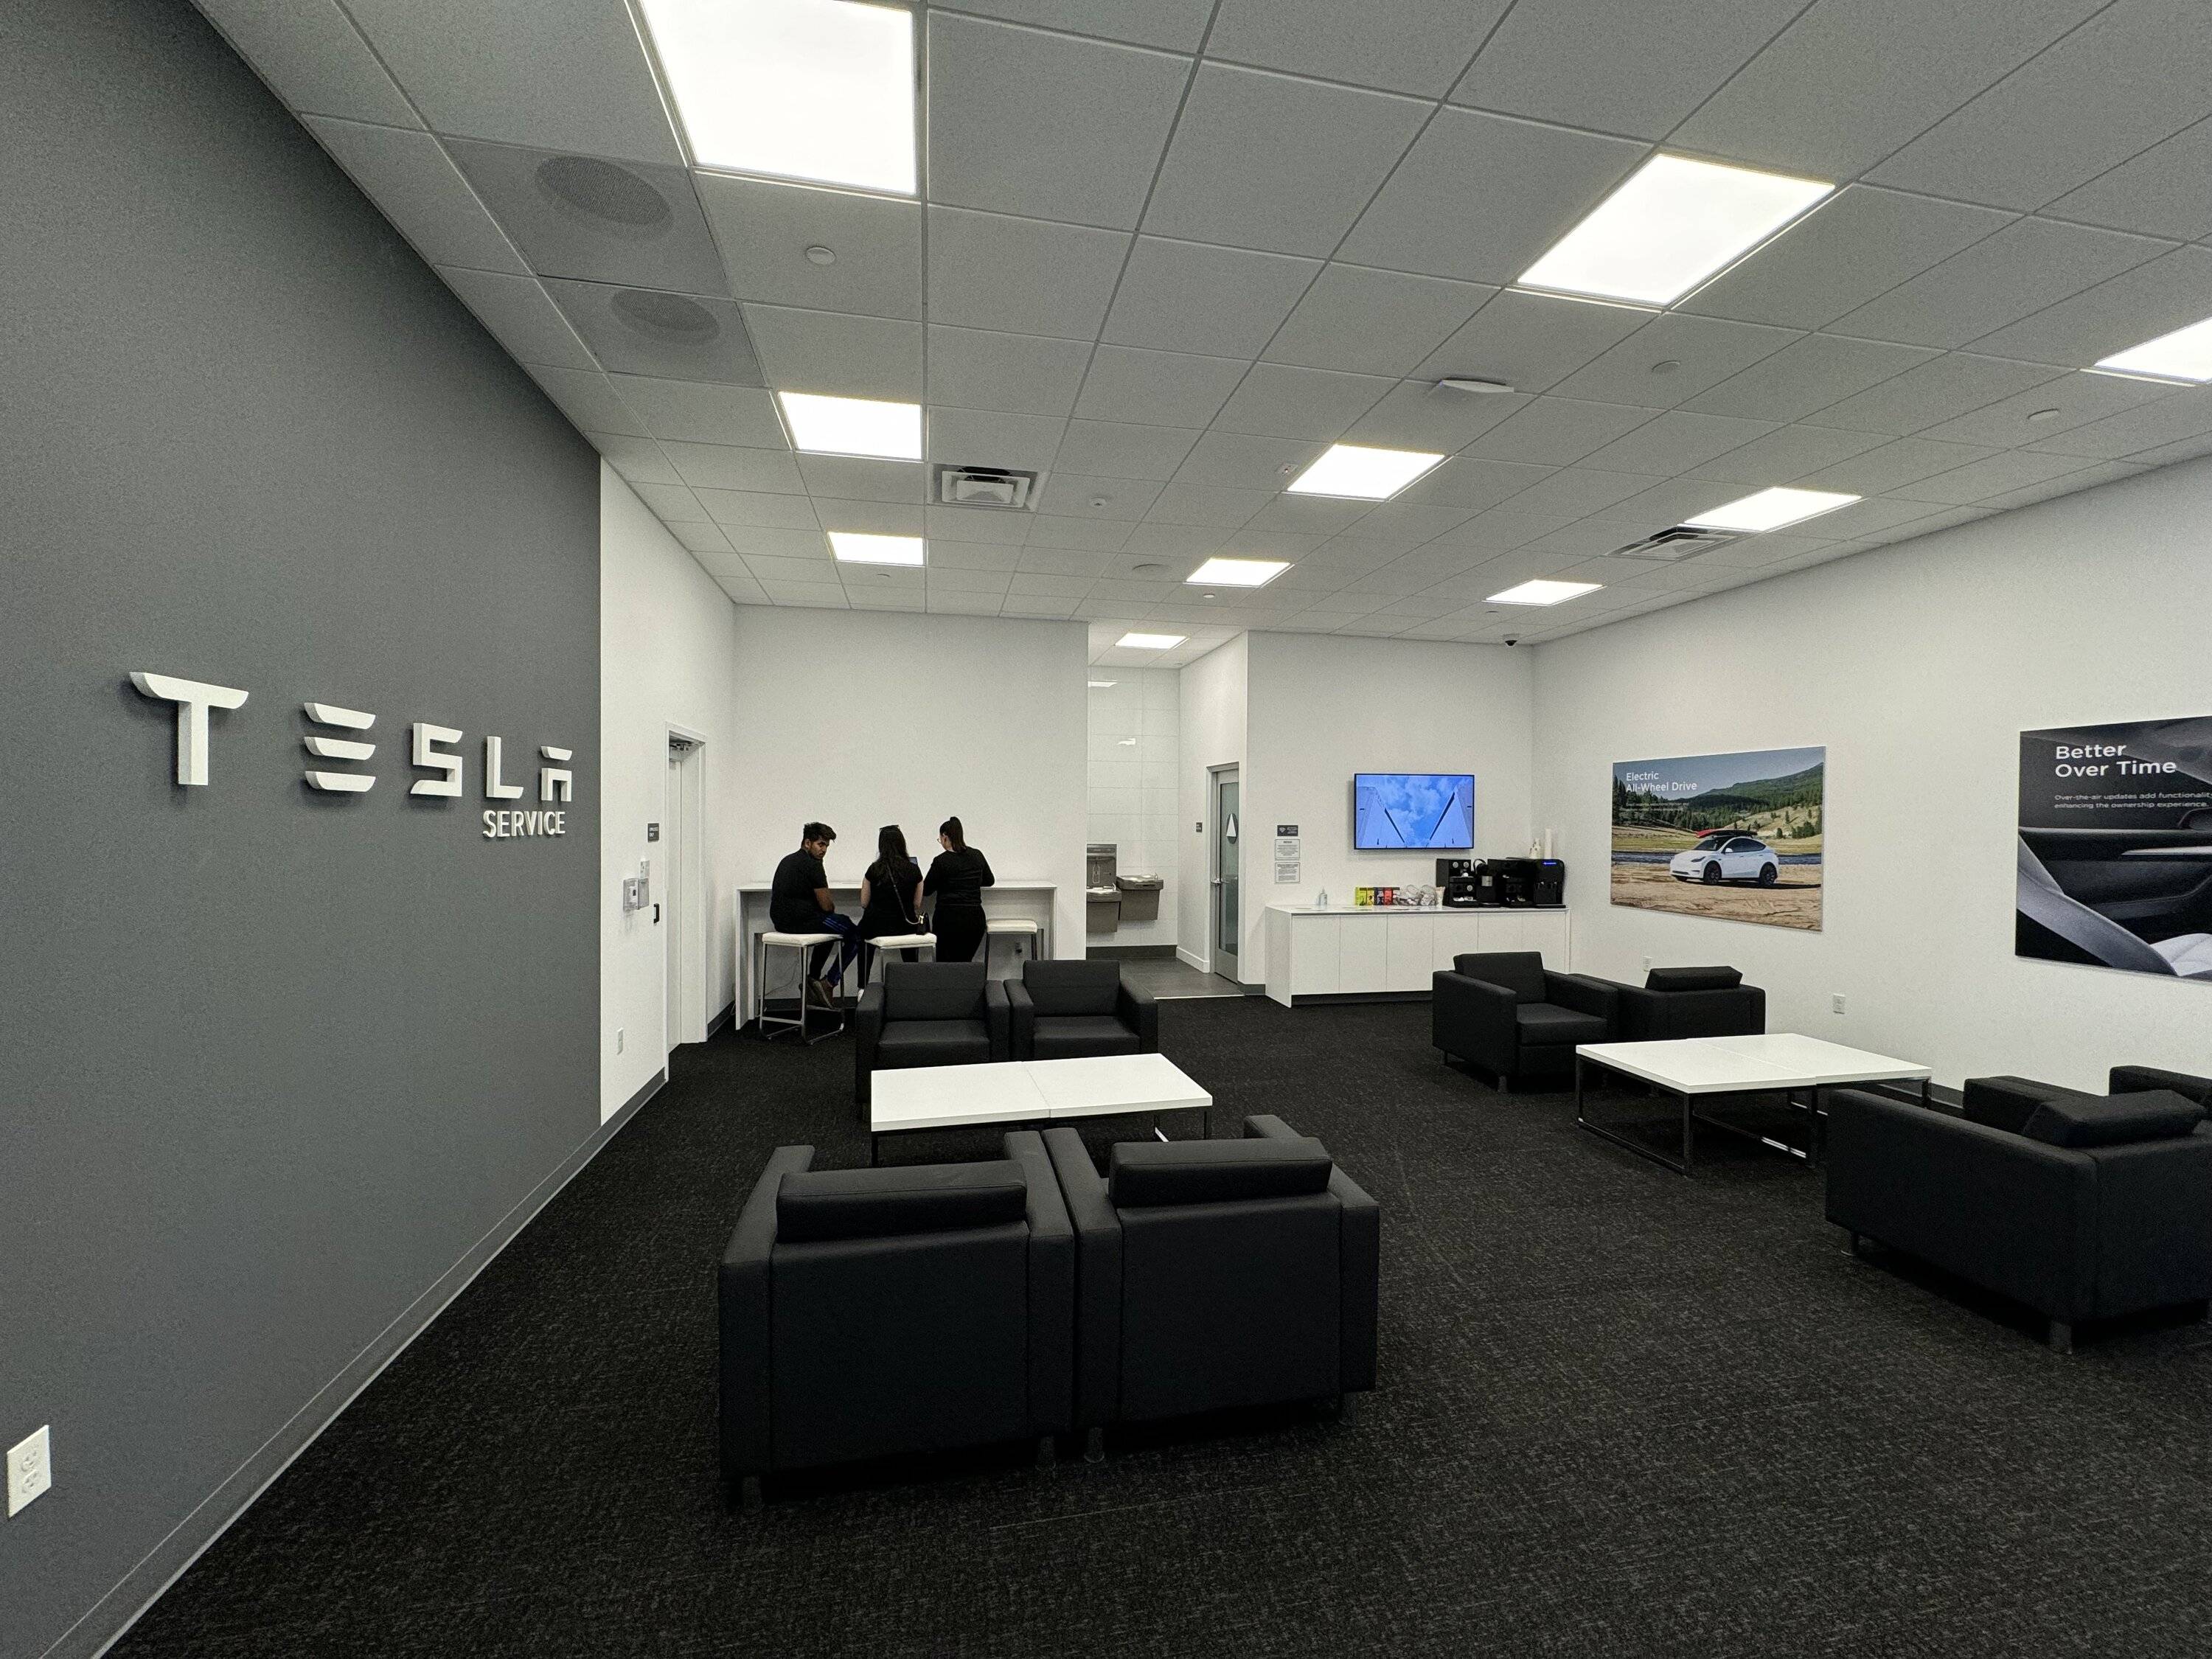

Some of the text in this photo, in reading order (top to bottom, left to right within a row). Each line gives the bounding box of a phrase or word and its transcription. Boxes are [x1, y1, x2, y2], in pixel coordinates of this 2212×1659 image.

[128, 671, 573, 802] TESLA
[2055, 744, 2127, 759] Better
[1626, 771, 1660, 782] Electric
[2055, 760, 2177, 778] Over Time
[1625, 782, 1697, 793] All-Wheel Drive
[482, 810, 566, 838] SERVICE
